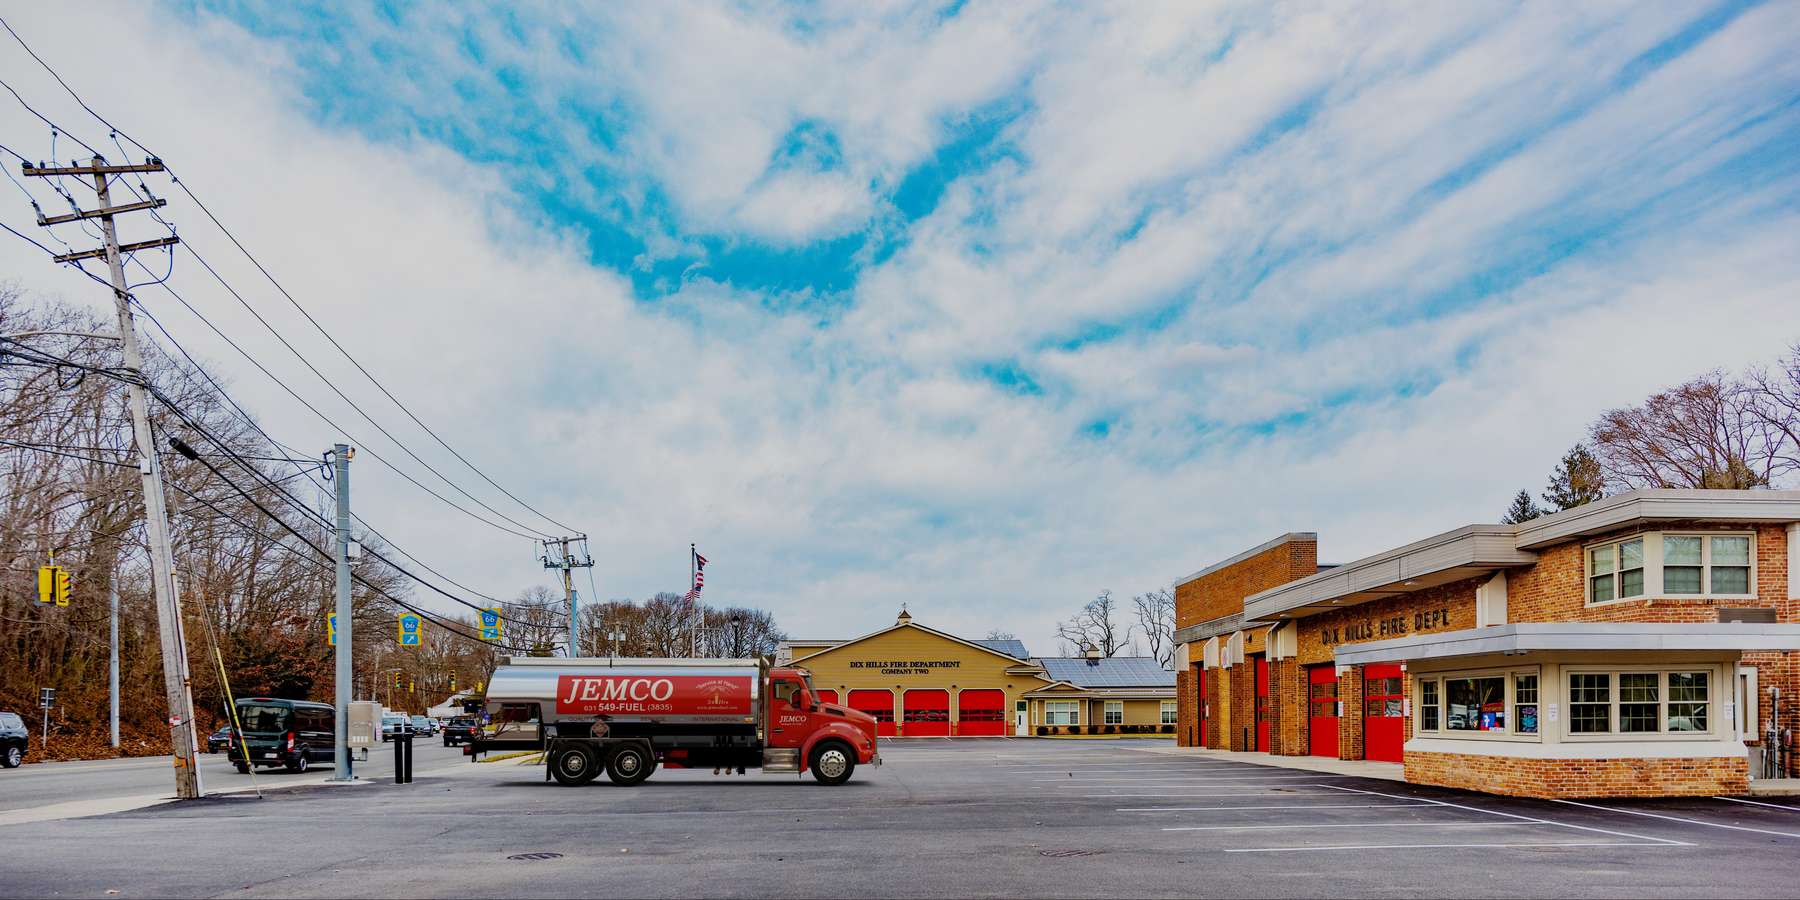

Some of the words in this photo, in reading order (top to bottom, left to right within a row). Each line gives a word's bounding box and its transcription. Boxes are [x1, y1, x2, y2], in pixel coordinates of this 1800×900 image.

[1344, 621, 1373, 640] HILLS
[1380, 616, 1407, 635] FIRE
[1414, 608, 1449, 630] DEPT
[563, 678, 674, 704] JEMCO
[598, 703, 645, 711] 549-FUEL
[647, 704, 673, 712] (3835)
[779, 715, 807, 723] JEMCO
